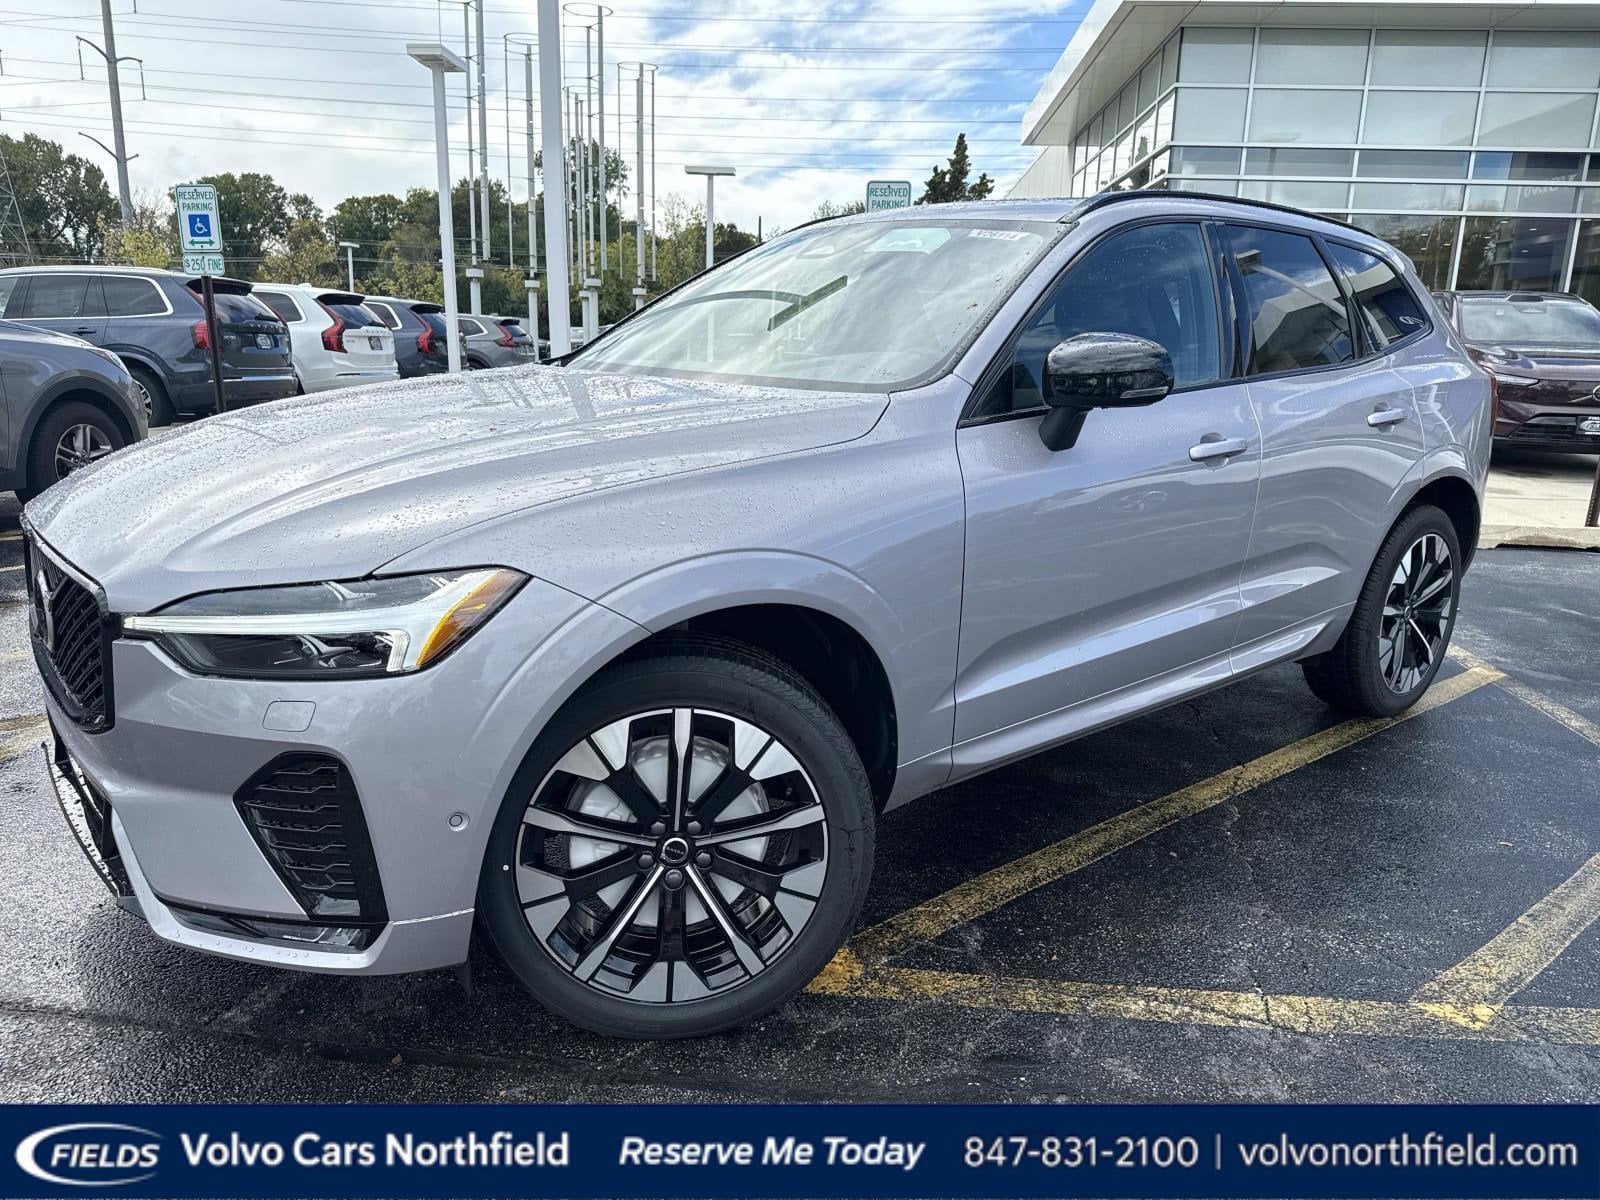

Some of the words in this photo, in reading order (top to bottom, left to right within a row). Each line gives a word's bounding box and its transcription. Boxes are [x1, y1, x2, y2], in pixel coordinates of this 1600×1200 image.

[178, 191, 214, 200] RESERVED
[869, 187, 908, 197] RESERVED
[182, 202, 213, 211] PARKING
[871, 199, 905, 209] PARKING
[184, 258, 206, 271] $250
[207, 258, 223, 271] FINE
